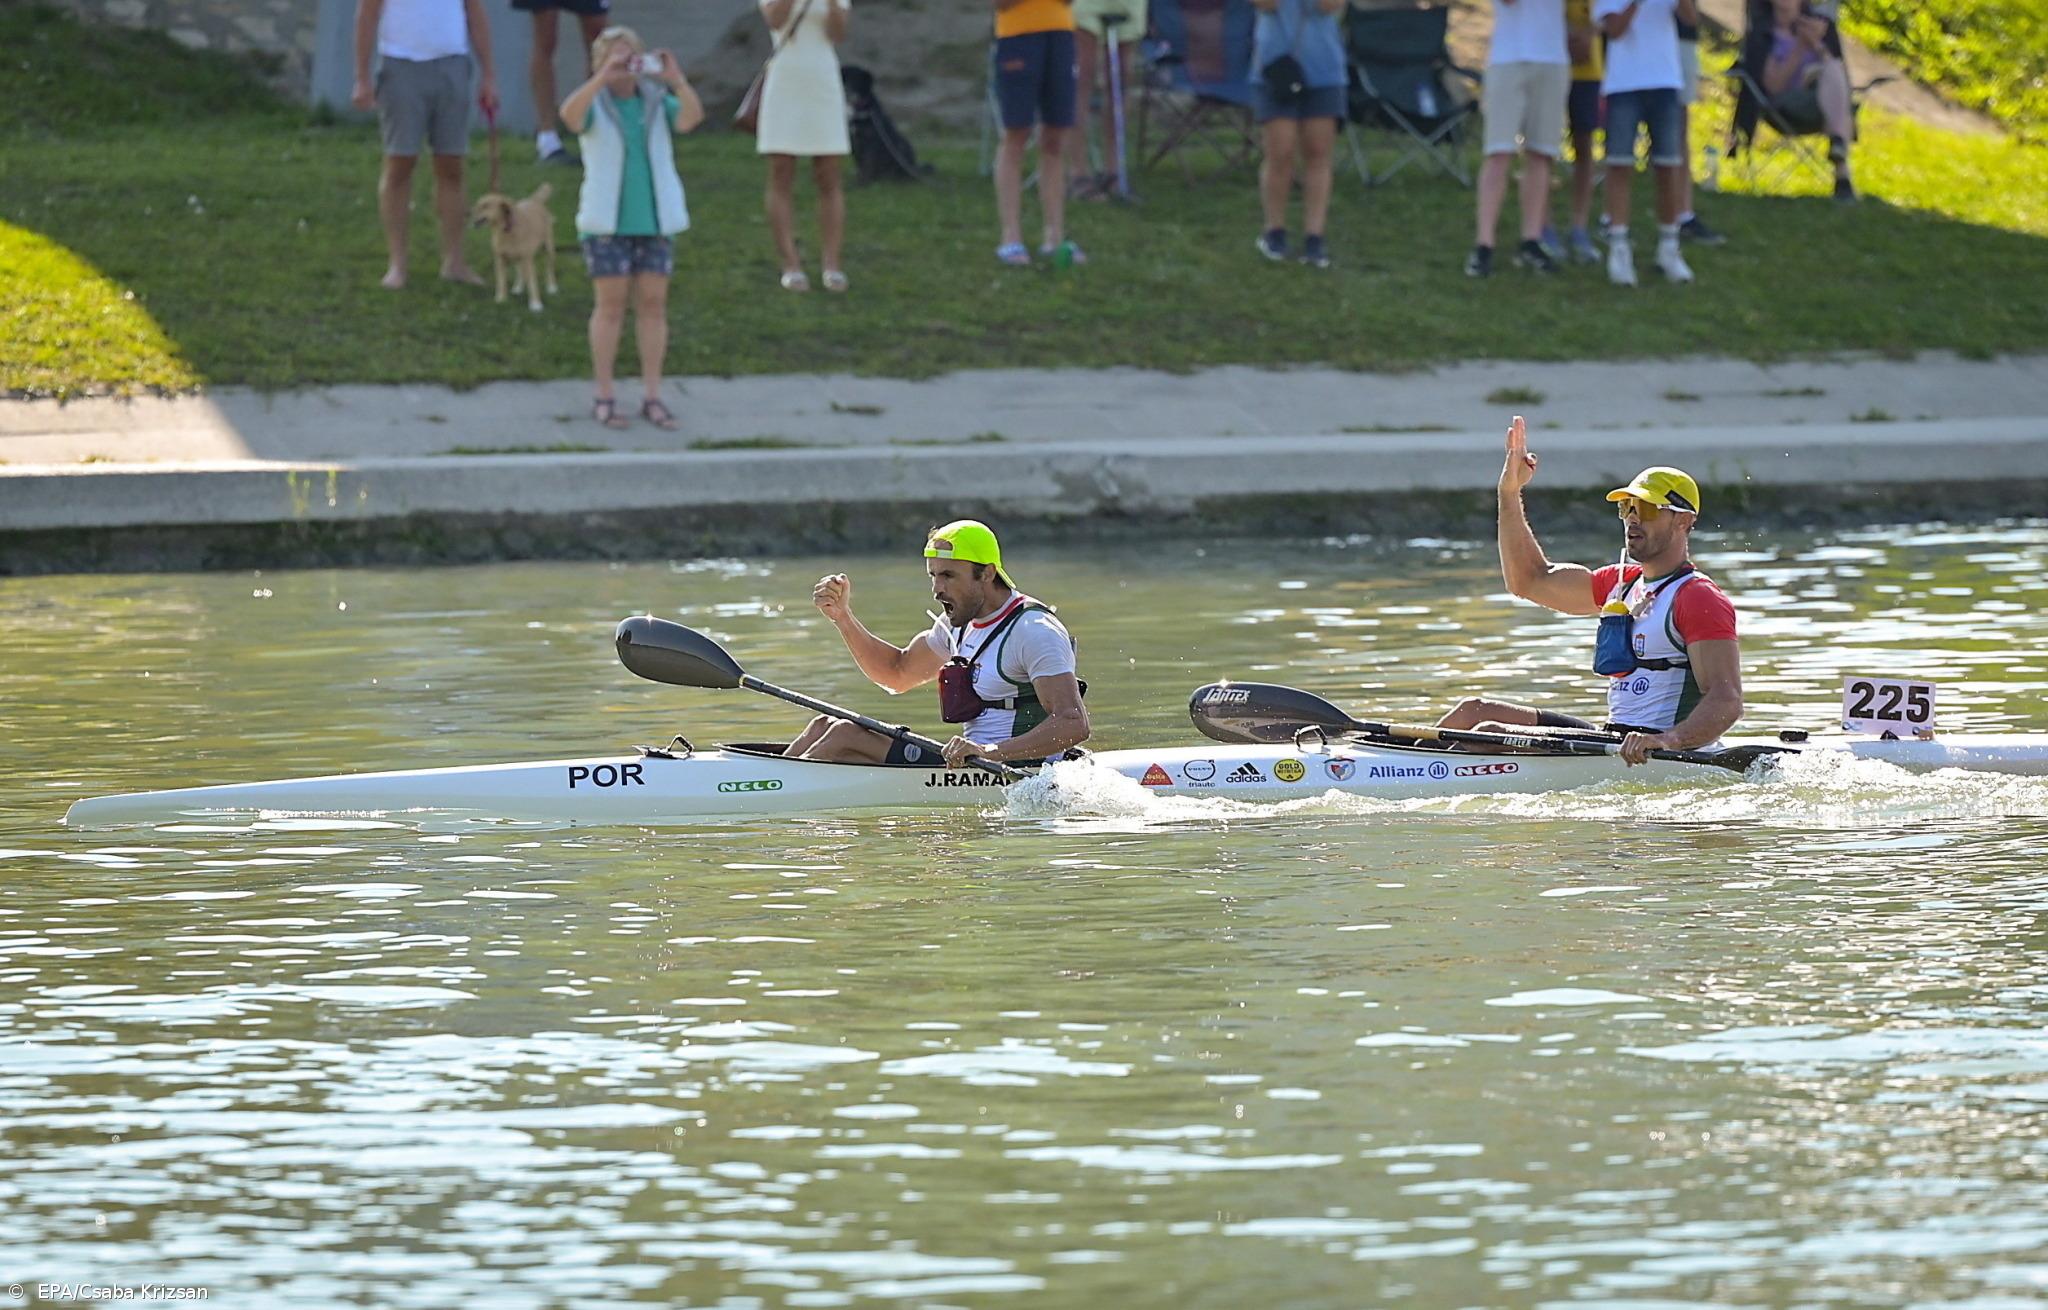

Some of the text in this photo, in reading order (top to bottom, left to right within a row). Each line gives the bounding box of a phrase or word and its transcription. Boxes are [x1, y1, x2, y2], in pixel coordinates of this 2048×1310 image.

[1849, 682, 1930, 723] 225
[568, 763, 646, 789] POR
[1369, 766, 1425, 778] Allianz
[1456, 763, 1518, 776] NELO
[924, 773, 1011, 788] J.RAMA
[1226, 774, 1267, 783] adidas
[718, 780, 782, 792] NELO
